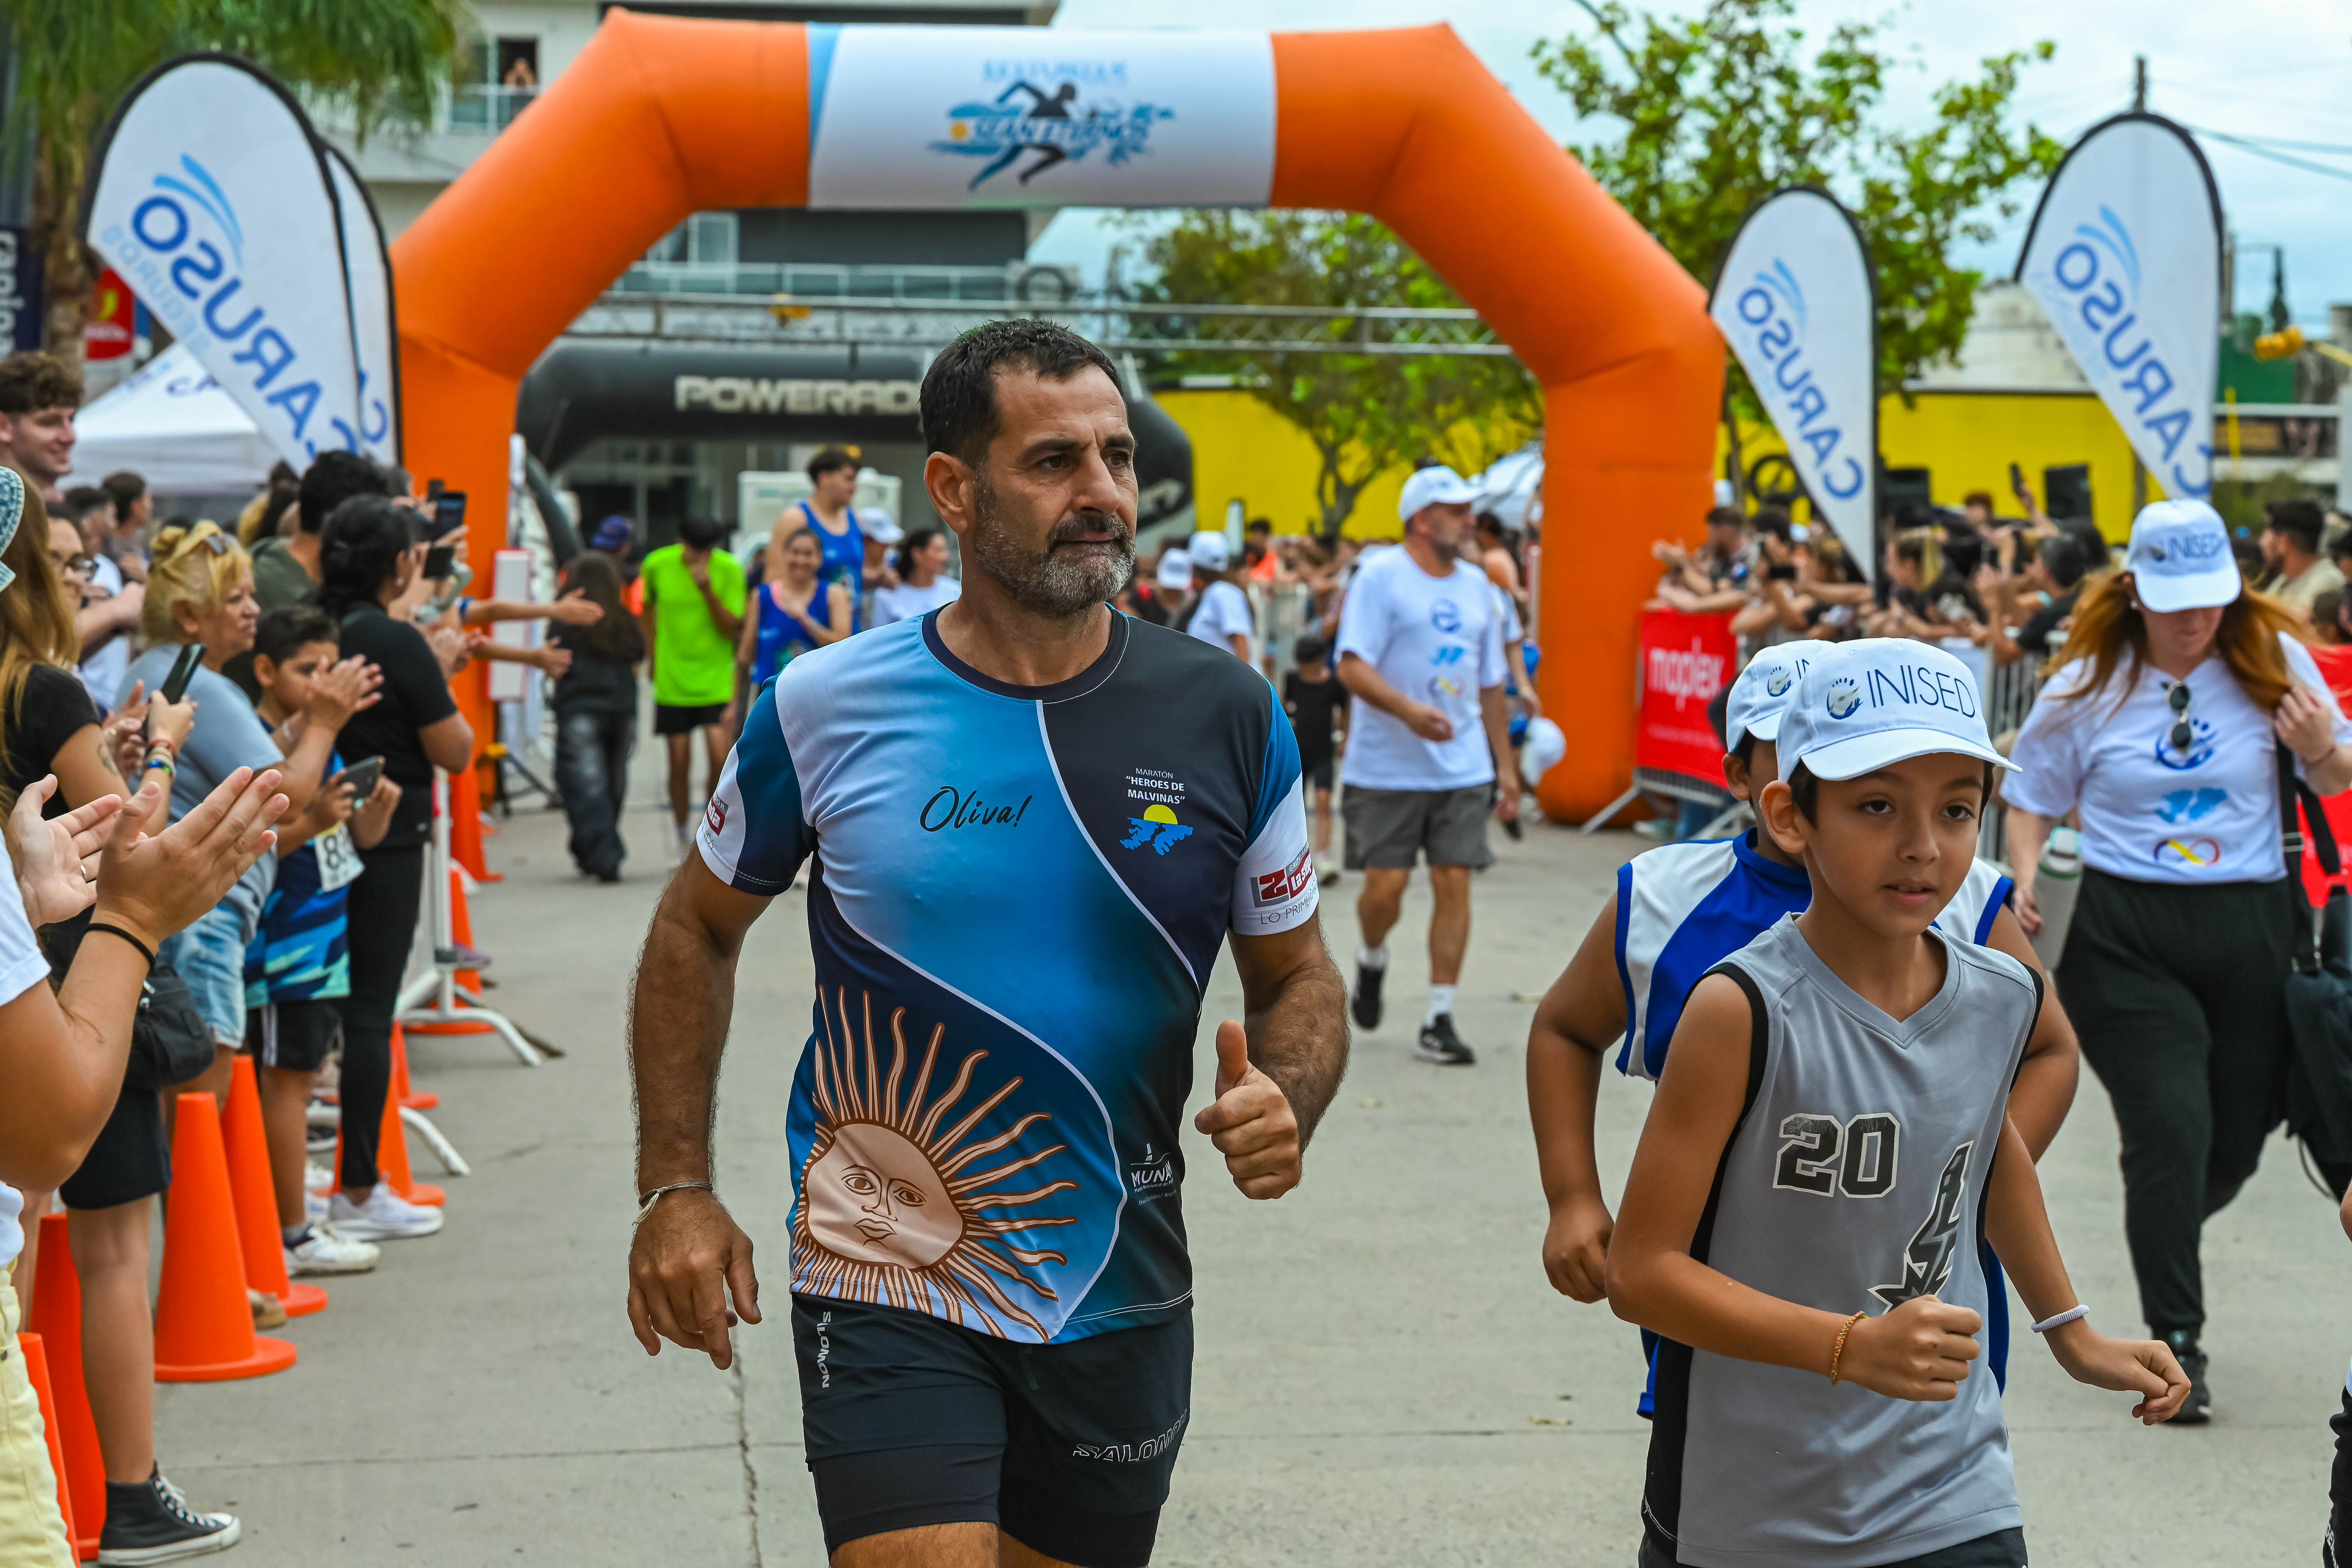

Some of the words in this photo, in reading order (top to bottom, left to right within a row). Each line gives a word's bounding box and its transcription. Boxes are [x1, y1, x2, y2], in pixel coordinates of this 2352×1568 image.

[674, 375, 921, 416] POWERAD
[1866, 665, 1976, 718] INISED
[1136, 768, 1173, 779] MARATÓN
[1172, 782, 1185, 791] DE
[919, 785, 1032, 833] Oliva!
[1289, 856, 1301, 872] GRUPO
[1260, 912, 1281, 925] LO
[1773, 1112, 1900, 1198] 20
